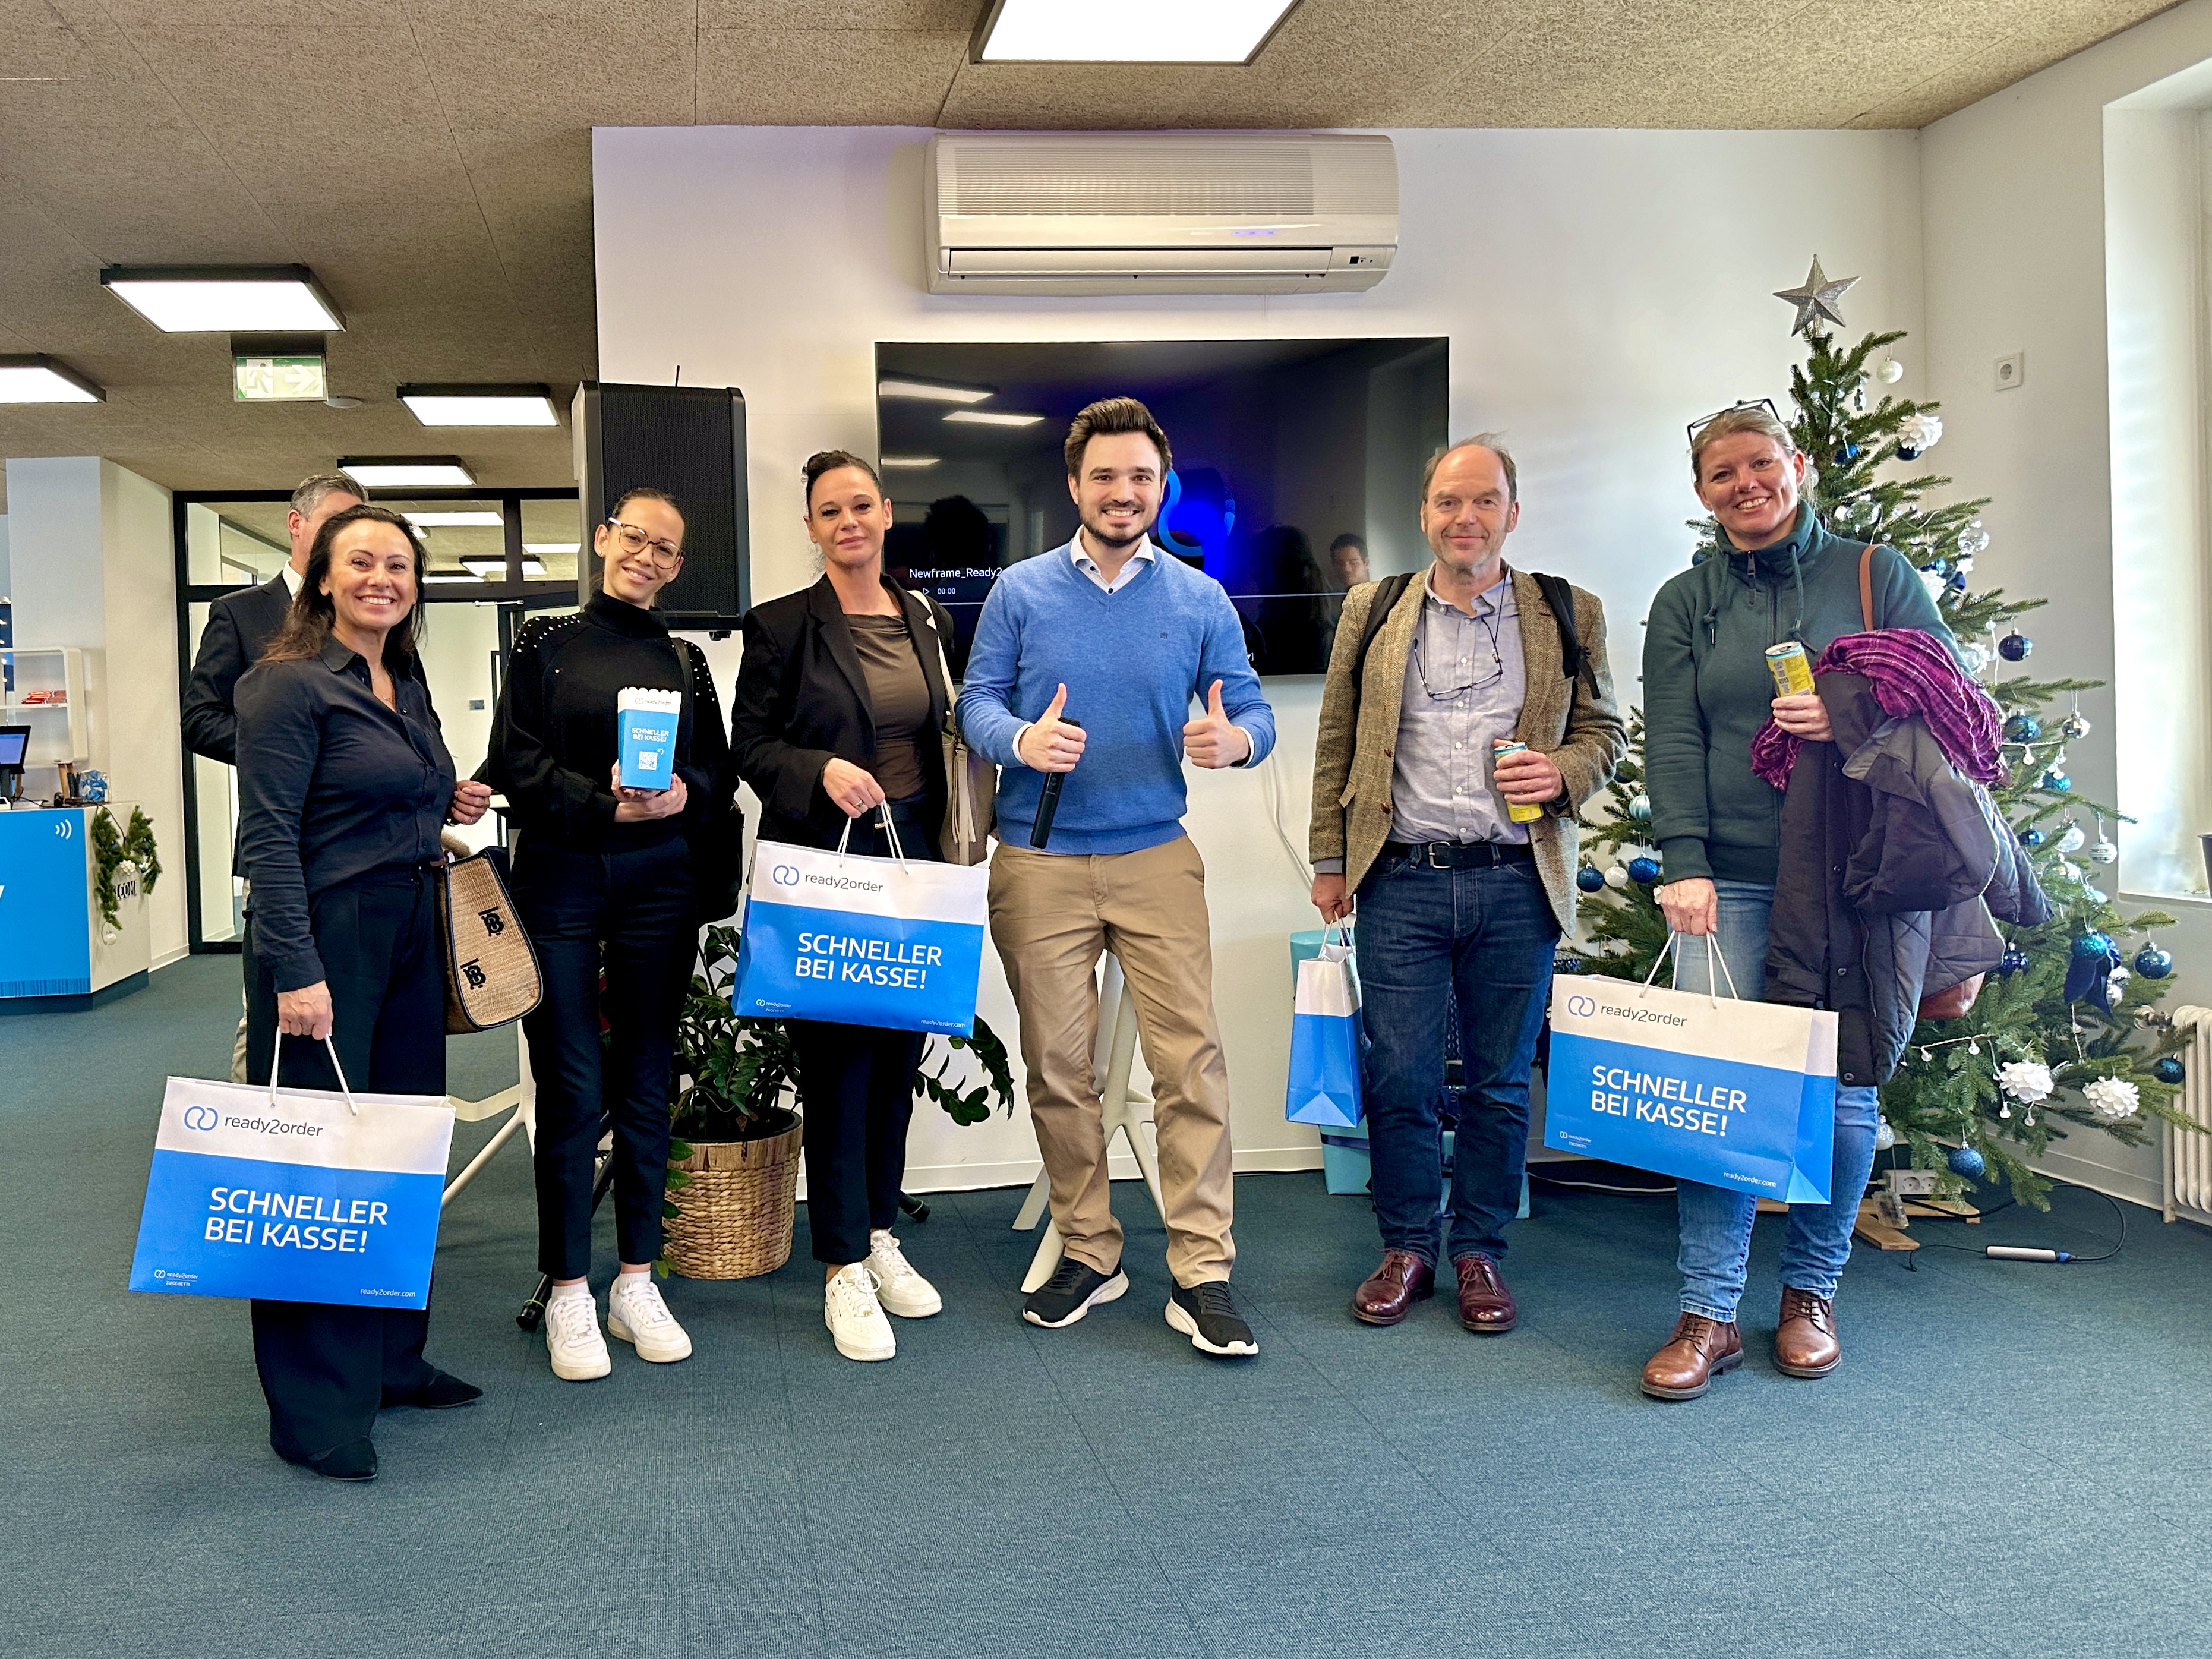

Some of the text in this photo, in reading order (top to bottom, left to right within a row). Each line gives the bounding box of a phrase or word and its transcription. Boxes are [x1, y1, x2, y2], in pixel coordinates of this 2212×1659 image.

[909, 567, 1003, 579] Newframe_Ready2
[631, 727, 670, 737] SCHNELLER
[804, 873, 884, 892] ready2order
[797, 932, 942, 966] SCHNELLER
[795, 956, 927, 989] BEI KASSE!
[920, 1019, 965, 1029] ready2order.com
[1600, 1005, 1688, 1027] ready2order
[1592, 1065, 1747, 1114] SCHNELLER
[1591, 1090, 1728, 1137] BEI KASSE!
[225, 1115, 324, 1137] ready2order
[1723, 1171, 1776, 1188] ready2order.com
[209, 1187, 389, 1225] SCHNELLER
[204, 1216, 368, 1253] BEI KASSE!
[359, 1288, 416, 1298] ready2order.com
